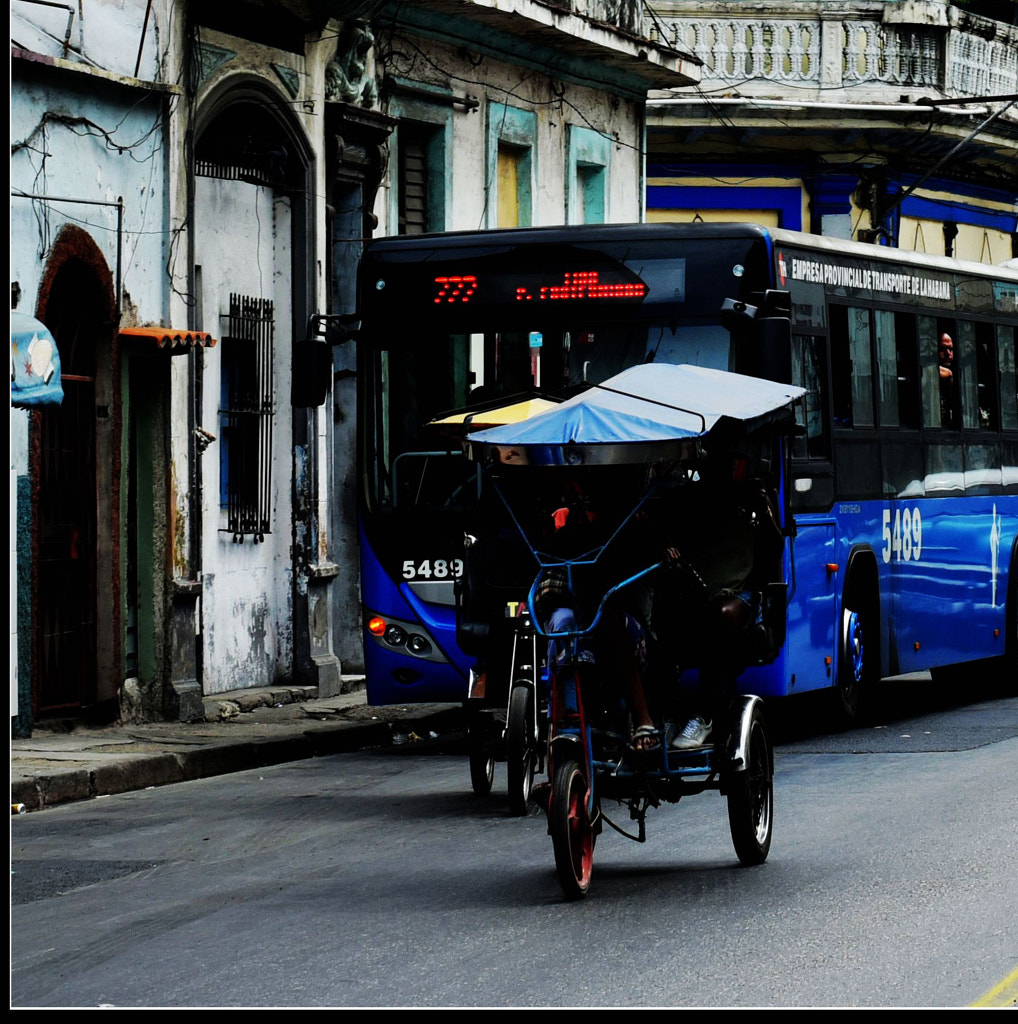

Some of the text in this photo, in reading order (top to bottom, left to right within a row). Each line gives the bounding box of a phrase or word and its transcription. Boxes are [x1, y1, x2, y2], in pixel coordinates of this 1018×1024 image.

[792, 258, 951, 300] EMPRESA PROVINCIAL DE TRANSPORTE DE LA HABANA
[882, 507, 922, 564] 5489
[402, 559, 464, 579] 5489
